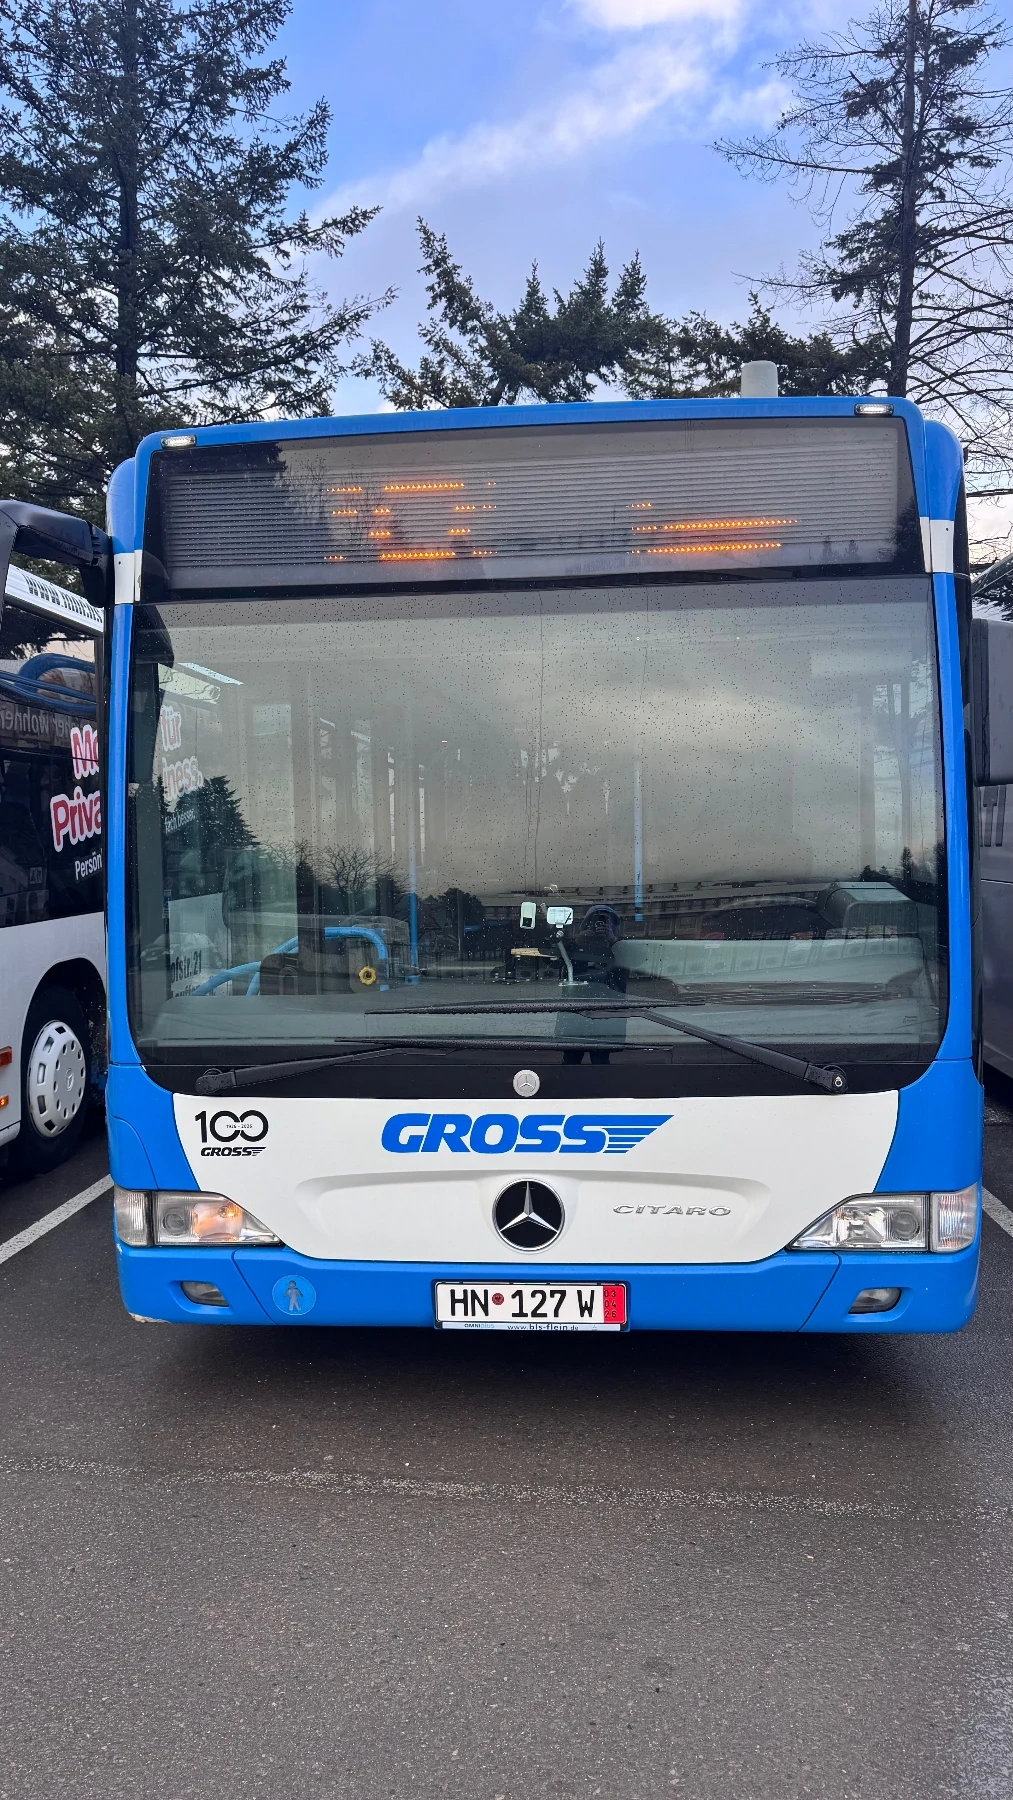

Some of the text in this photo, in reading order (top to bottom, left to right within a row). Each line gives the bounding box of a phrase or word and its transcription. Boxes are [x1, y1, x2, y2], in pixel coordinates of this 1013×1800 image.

[75, 848, 102, 880] Persön
[195, 1110, 269, 1143] 100
[381, 1113, 674, 1154] GROSS
[201, 1147, 266, 1156] GROSS
[613, 1204, 731, 1216] CITARO
[450, 1289, 595, 1318] HN 127 W
